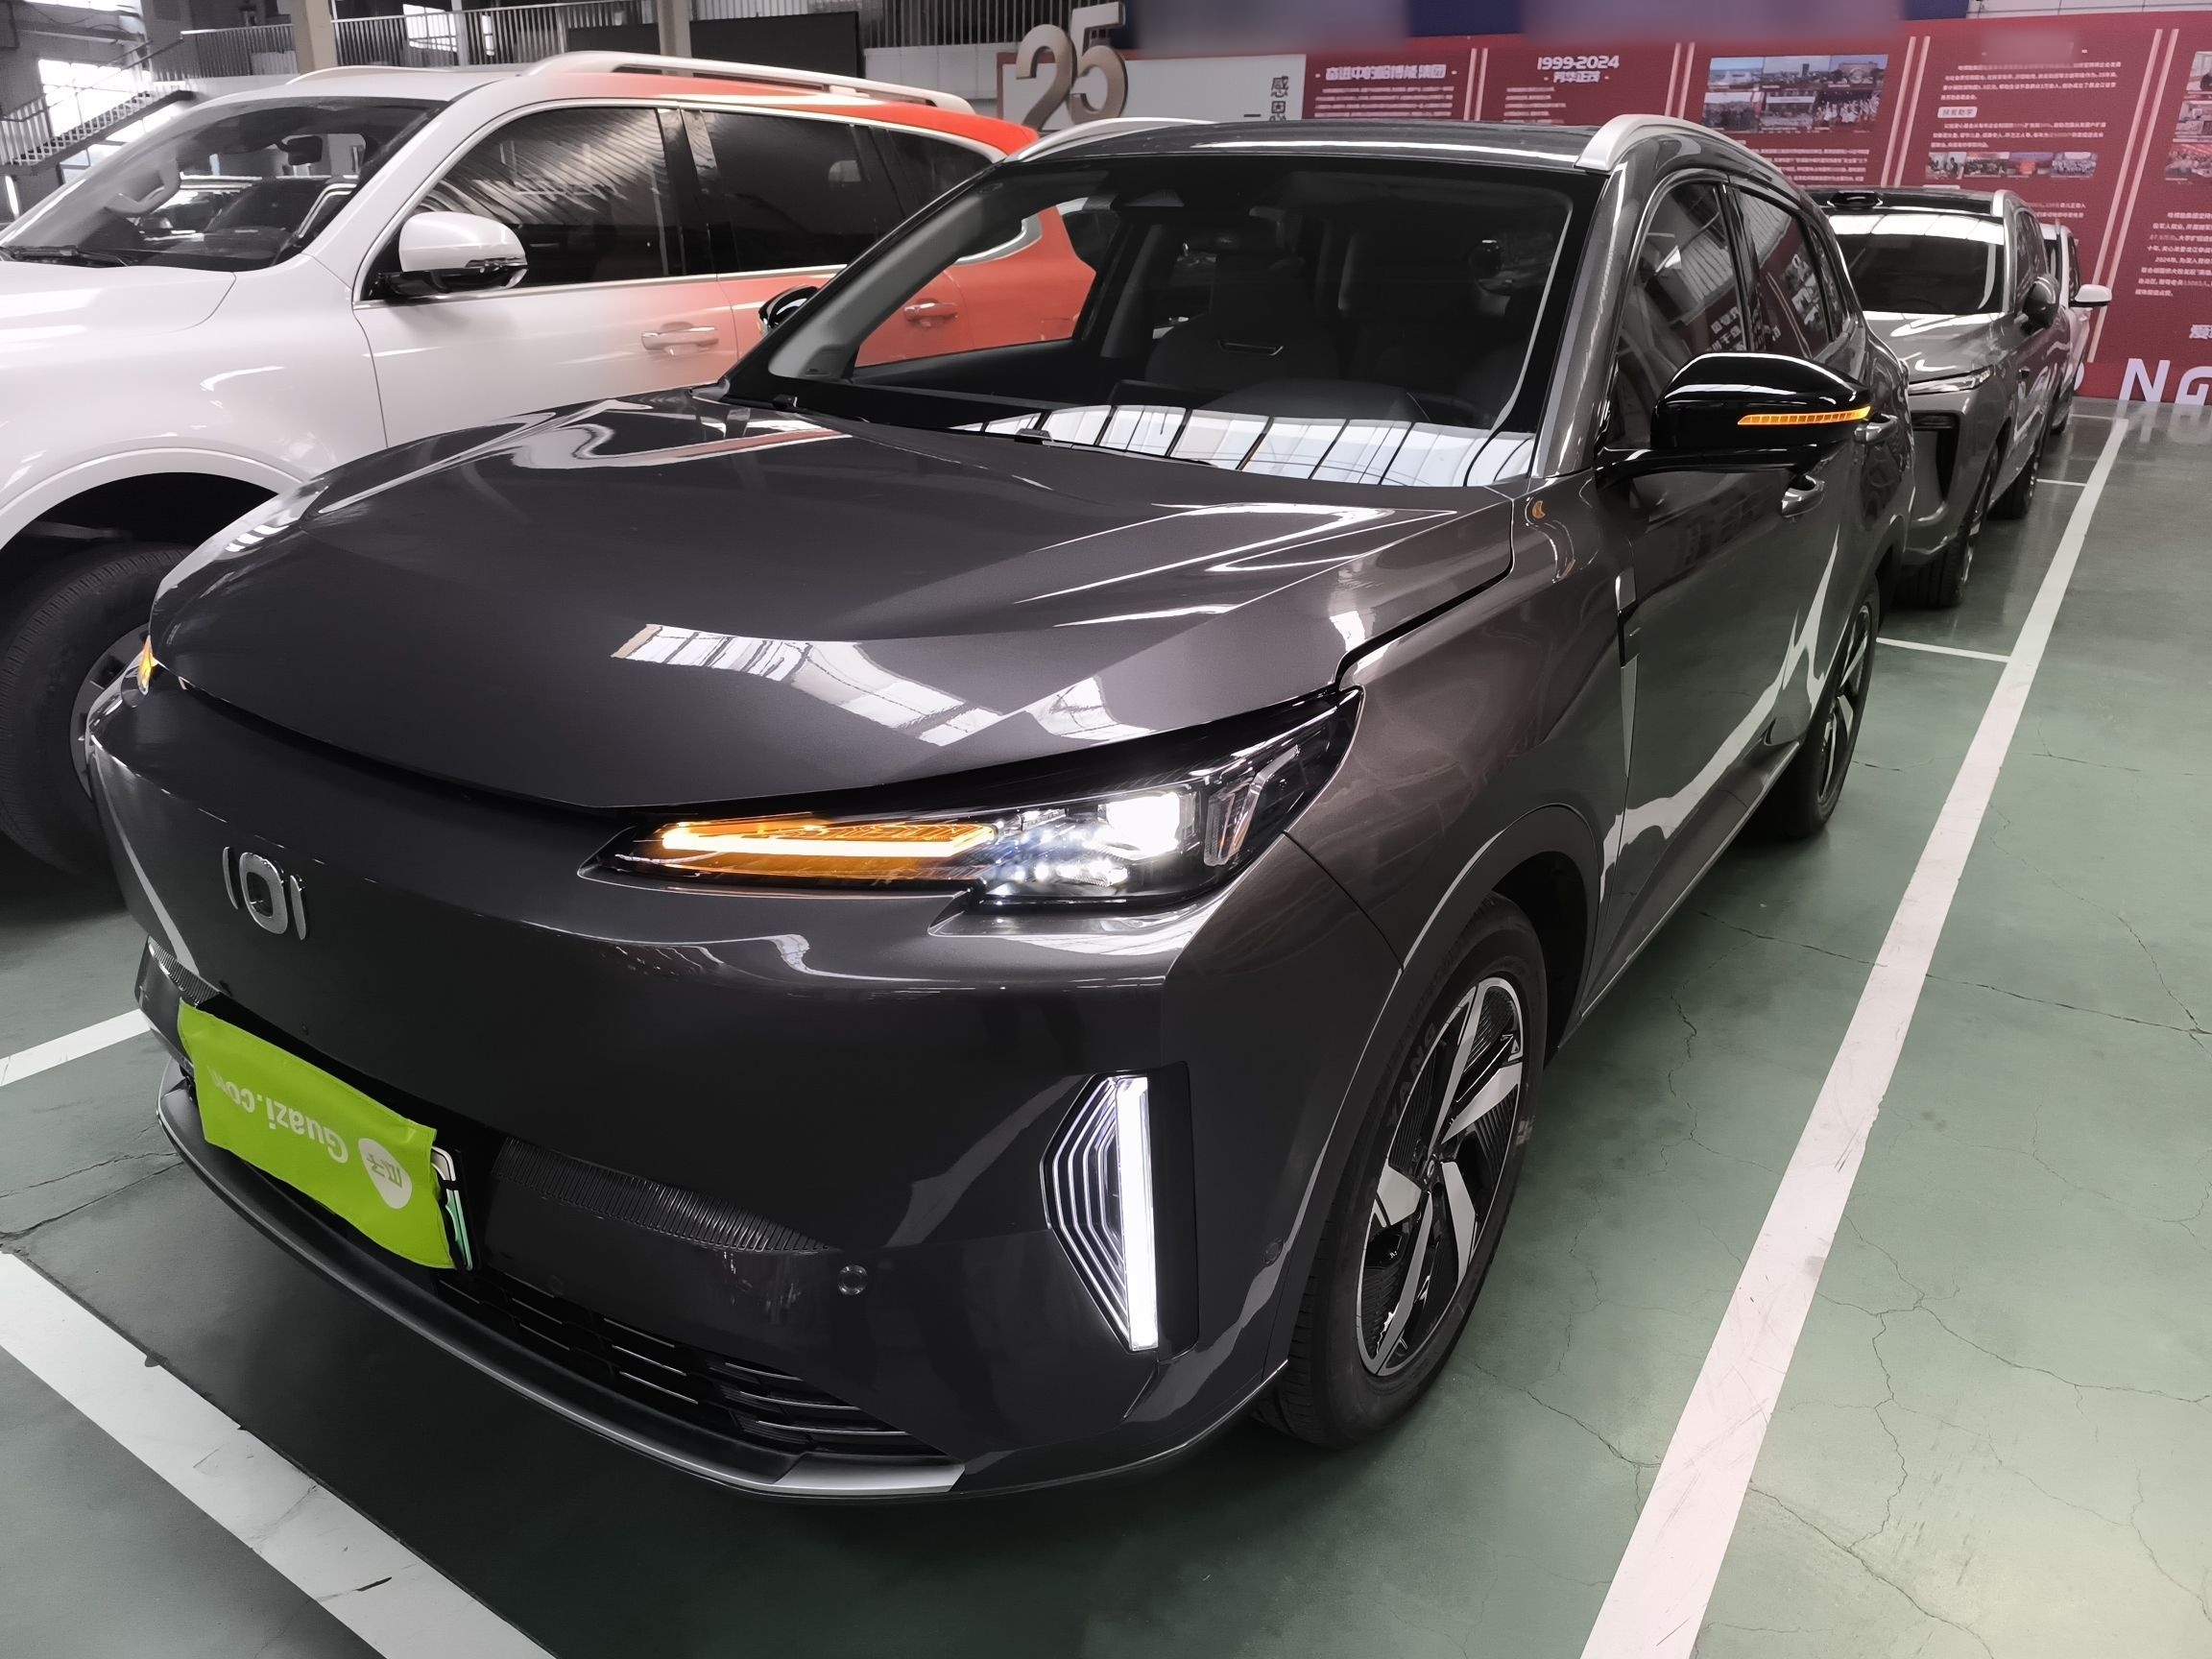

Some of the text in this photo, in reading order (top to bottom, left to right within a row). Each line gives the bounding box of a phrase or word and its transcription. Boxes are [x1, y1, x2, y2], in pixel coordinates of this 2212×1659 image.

[1015, 1, 1128, 132] 25
[1537, 55, 1620, 70] 1999-2024
[207, 1067, 349, 1164] Guazi.com
